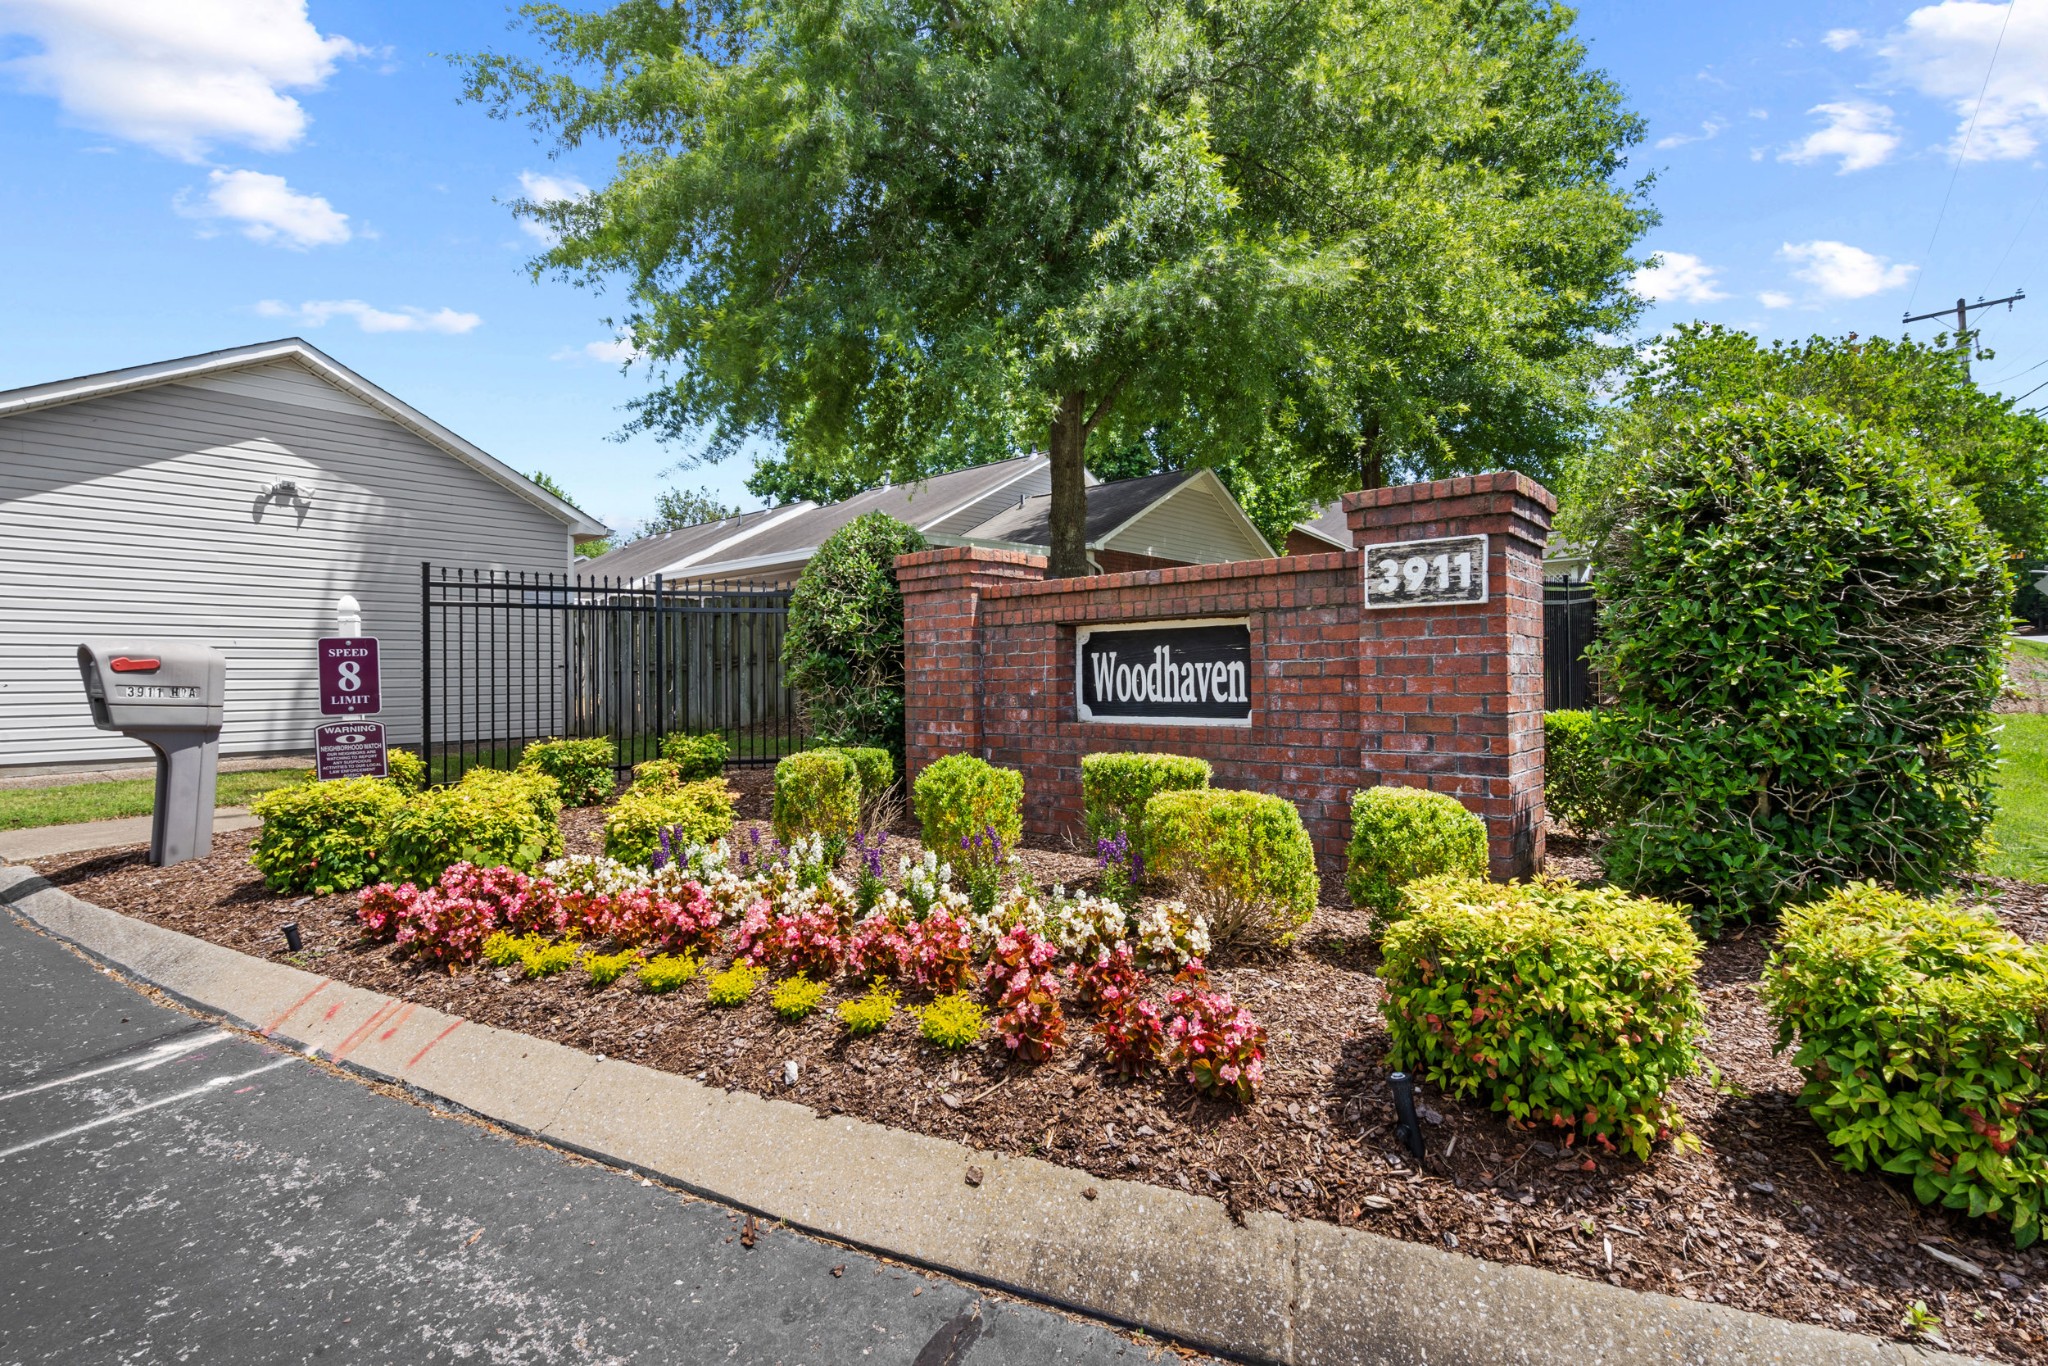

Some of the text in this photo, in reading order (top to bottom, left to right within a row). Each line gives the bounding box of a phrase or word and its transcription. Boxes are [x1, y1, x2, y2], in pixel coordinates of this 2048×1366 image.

[1377, 552, 1471, 594] 3911
[328, 648, 369, 658] SPEED
[338, 660, 362, 692] 8
[1091, 645, 1248, 703] Woodhaven
[127, 686, 164, 698] 3911
[331, 695, 371, 705] LIMIT
[324, 725, 376, 734] WARNING
[321, 744, 363, 752] NEIGHBORHOOD
